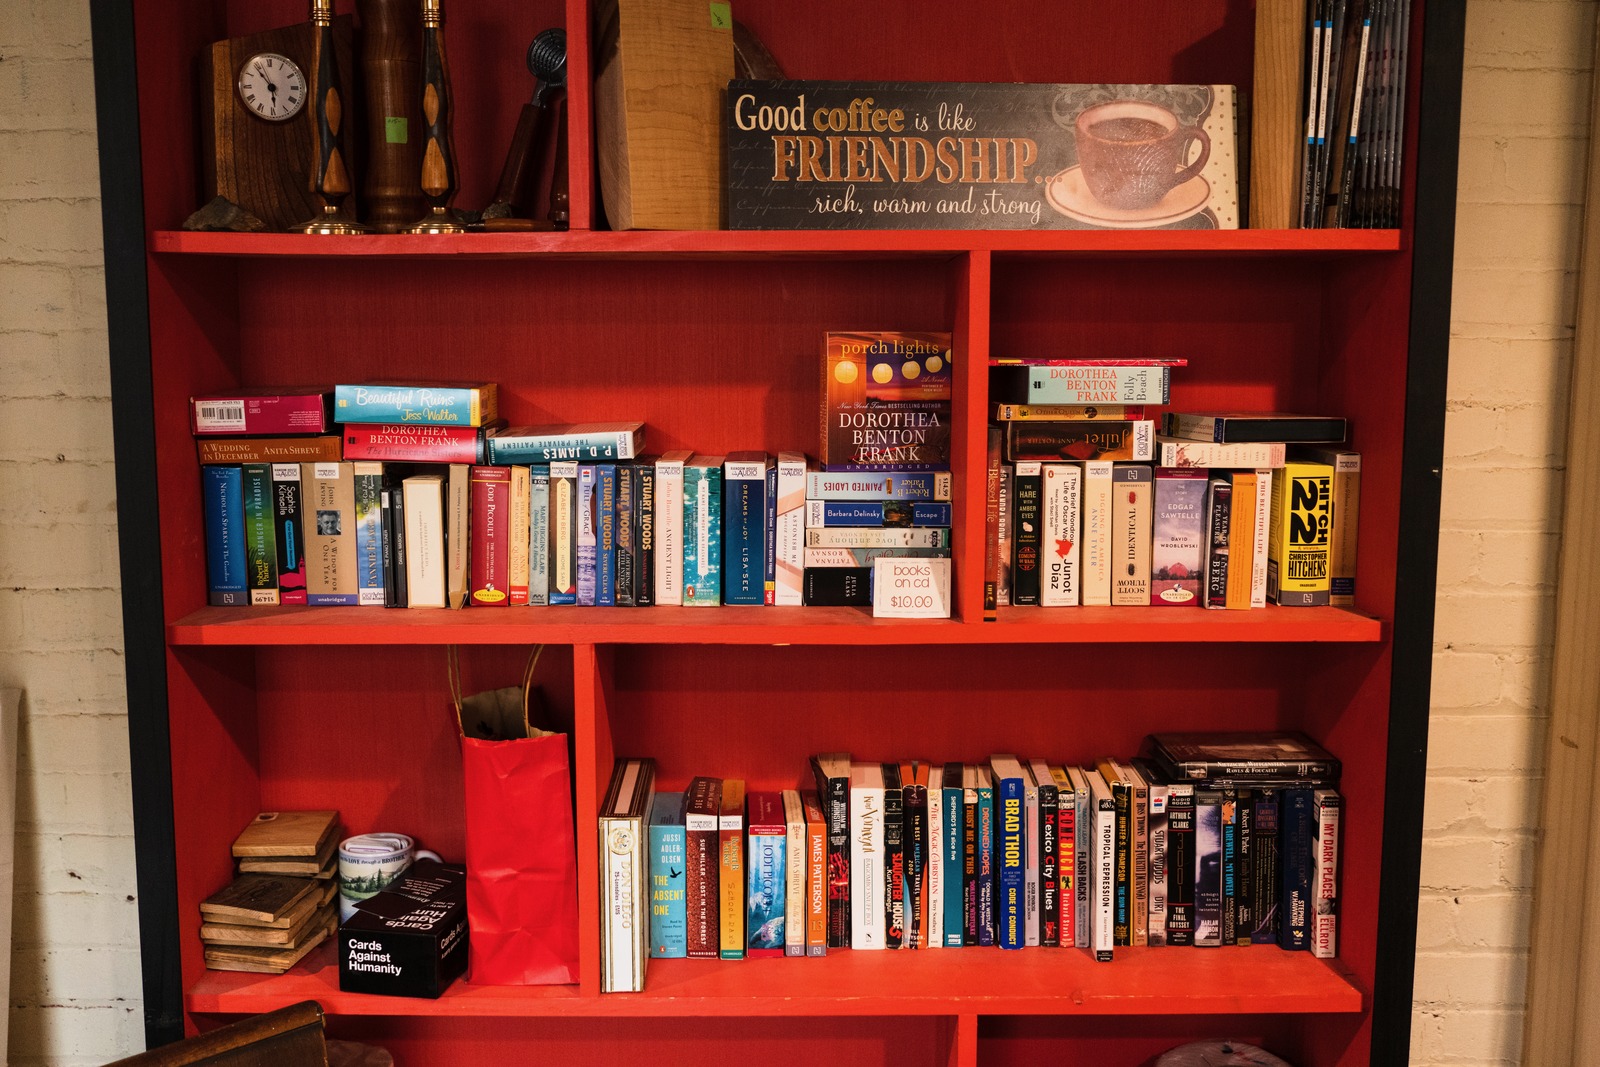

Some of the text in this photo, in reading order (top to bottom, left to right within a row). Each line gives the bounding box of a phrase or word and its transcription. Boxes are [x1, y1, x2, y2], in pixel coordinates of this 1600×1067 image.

[735, 94, 977, 132] Good coffee is like
[809, 184, 1042, 225] rich, warm and strong
[841, 340, 939, 359] porch lights
[1050, 368, 1118, 379] DOROTHEA
[1066, 380, 1117, 390] BENTON
[1124, 375, 1138, 401] Folly
[1136, 370, 1147, 401] Beach
[353, 387, 455, 410] Beautiful Ruins
[1077, 391, 1118, 402] FRANK
[837, 401, 852, 409] New
[853, 401, 868, 410] York
[869, 401, 887, 409] Times
[400, 408, 459, 422] Jess Walter
[839, 412, 941, 428] DOROTHEA
[381, 425, 448, 437] DOROTHEA
[852, 430, 926, 445] BENTON
[209, 444, 250, 452] WEDDING
[369, 435, 460, 447] BENTON FRANK
[214, 452, 259, 460] DECEMBER
[263, 446, 321, 455] ANITA SHREVE
[543, 447, 581, 460] JAMES
[859, 446, 920, 461] FRANK
[823, 482, 849, 491] LADIES
[851, 482, 883, 492] PAINTED
[900, 479, 925, 488] Parker
[253, 478, 262, 510] PARADISE
[278, 484, 286, 516] Kinsella
[287, 486, 297, 514] Sophie
[327, 486, 335, 505] JOHN
[583, 485, 591, 502] FULL
[905, 488, 930, 497] Robert
[1019, 490, 1036, 498] HARE
[1063, 496, 1069, 504] of
[485, 482, 496, 538] JODI PICOULT
[602, 477, 613, 551] STUART WOODS
[619, 469, 631, 548] STUART WOODS
[641, 475, 653, 551] STUART WOODS
[827, 509, 881, 519] Barbara Delinsky
[915, 510, 938, 519] Escape
[1289, 479, 1319, 544] 22
[1317, 479, 1330, 544] HITCH
[221, 518, 229, 544] SPARKS
[582, 510, 591, 536] GRACE
[1128, 508, 1136, 561] IDENTICAL
[262, 562, 270, 582] Parker
[893, 564, 931, 576] books
[1050, 563, 1061, 590] Díaz
[1063, 559, 1073, 594] Junot
[1211, 560, 1220, 591] BERG
[1288, 560, 1327, 578] HITCHENS
[894, 577, 930, 588] on cd
[890, 595, 933, 608] $10.00
[1005, 798, 1020, 833] BRAD
[1169, 811, 1186, 820] ARTHUR
[1172, 820, 1189, 829] CLARKE
[1241, 808, 1250, 855] Robert Parker
[661, 833, 681, 842] JUSSI
[661, 855, 681, 864] OLSEN
[763, 844, 773, 869] JODI
[1005, 834, 1020, 868] THOR
[1042, 814, 1055, 911] Mexico City Blues
[1102, 824, 1111, 908] TROPICAL DEPRESSION
[1322, 823, 1335, 900] MY DARK PLACES
[812, 834, 822, 914] JAMES PATTERSON
[1077, 851, 1087, 901] FLASH BACKS
[1153, 830, 1165, 913] STUART WOODS DIRT
[653, 875, 669, 887] THE
[653, 889, 685, 901] ABSENT
[885, 883, 893, 913] Vonnegut
[891, 852, 903, 930] SLAUGHTER HOUSE
[1008, 887, 1017, 905] CODE
[653, 904, 670, 916] ONE
[1008, 905, 1016, 915] OF
[1172, 913, 1187, 921] FINAL
[1174, 907, 1184, 915] THE
[1008, 915, 1016, 946] CONDUCT
[1169, 921, 1190, 929] ODYSSEY
[1319, 918, 1329, 950] ELLROY
[348, 938, 382, 951] Cards
[348, 950, 391, 963] Against
[348, 961, 402, 977] Humanity
